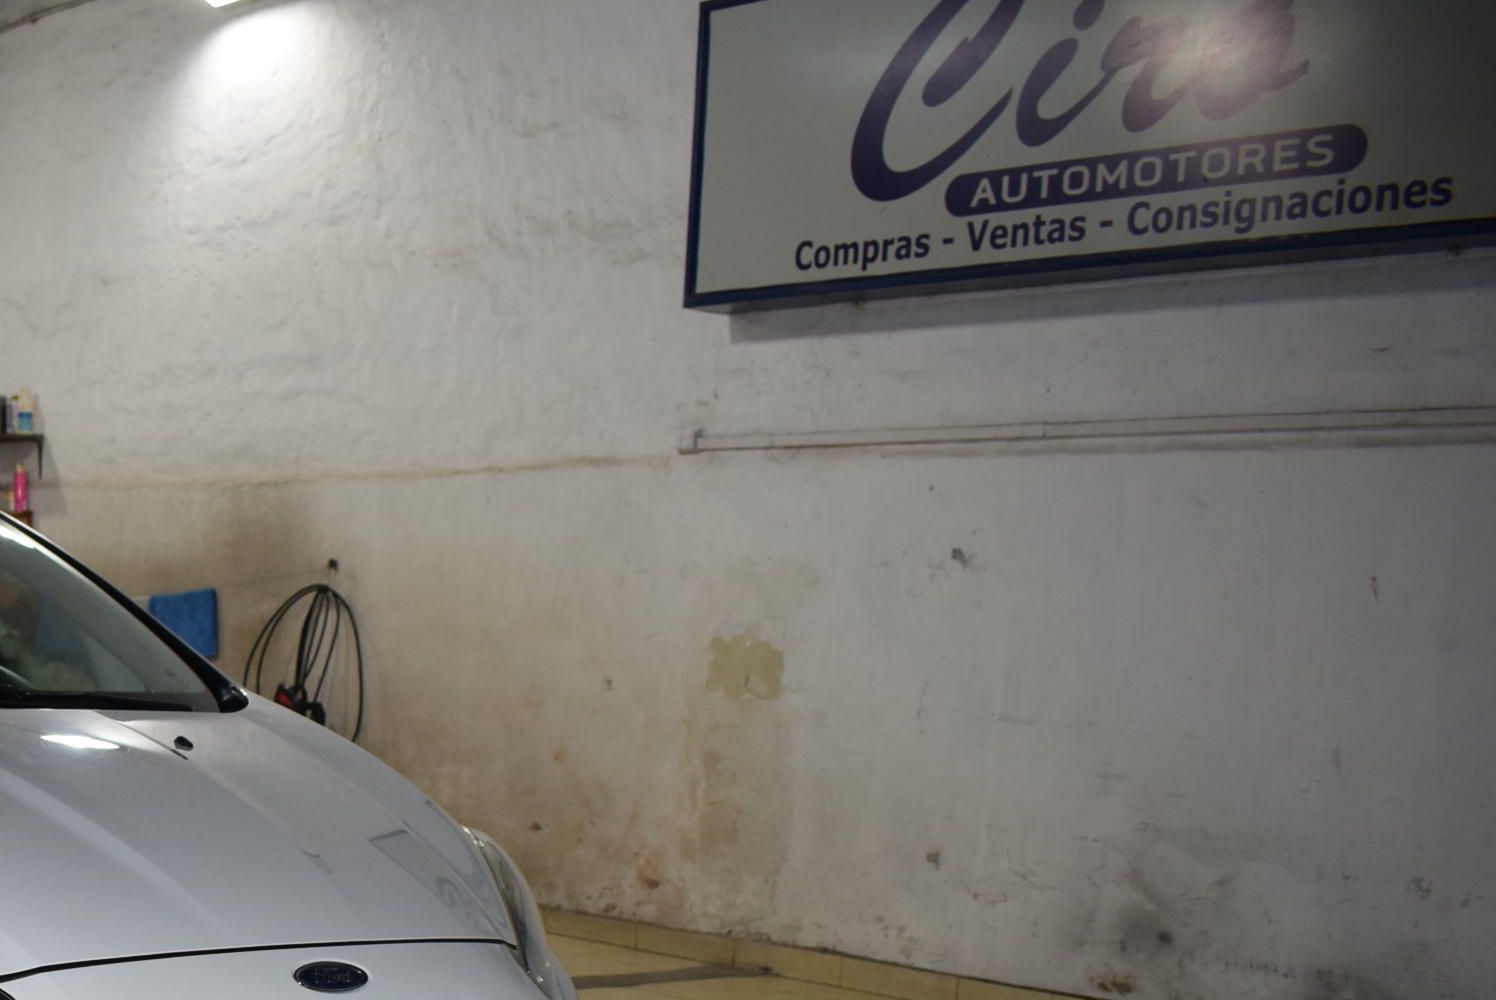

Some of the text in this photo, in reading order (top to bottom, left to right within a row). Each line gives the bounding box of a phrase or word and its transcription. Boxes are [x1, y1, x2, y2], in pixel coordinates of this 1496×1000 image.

[969, 134, 1334, 208] AUTOMOTORES
[794, 232, 931, 272] Compras
[966, 213, 1087, 252] Ventas
[1126, 176, 1454, 236] Consignaciones
